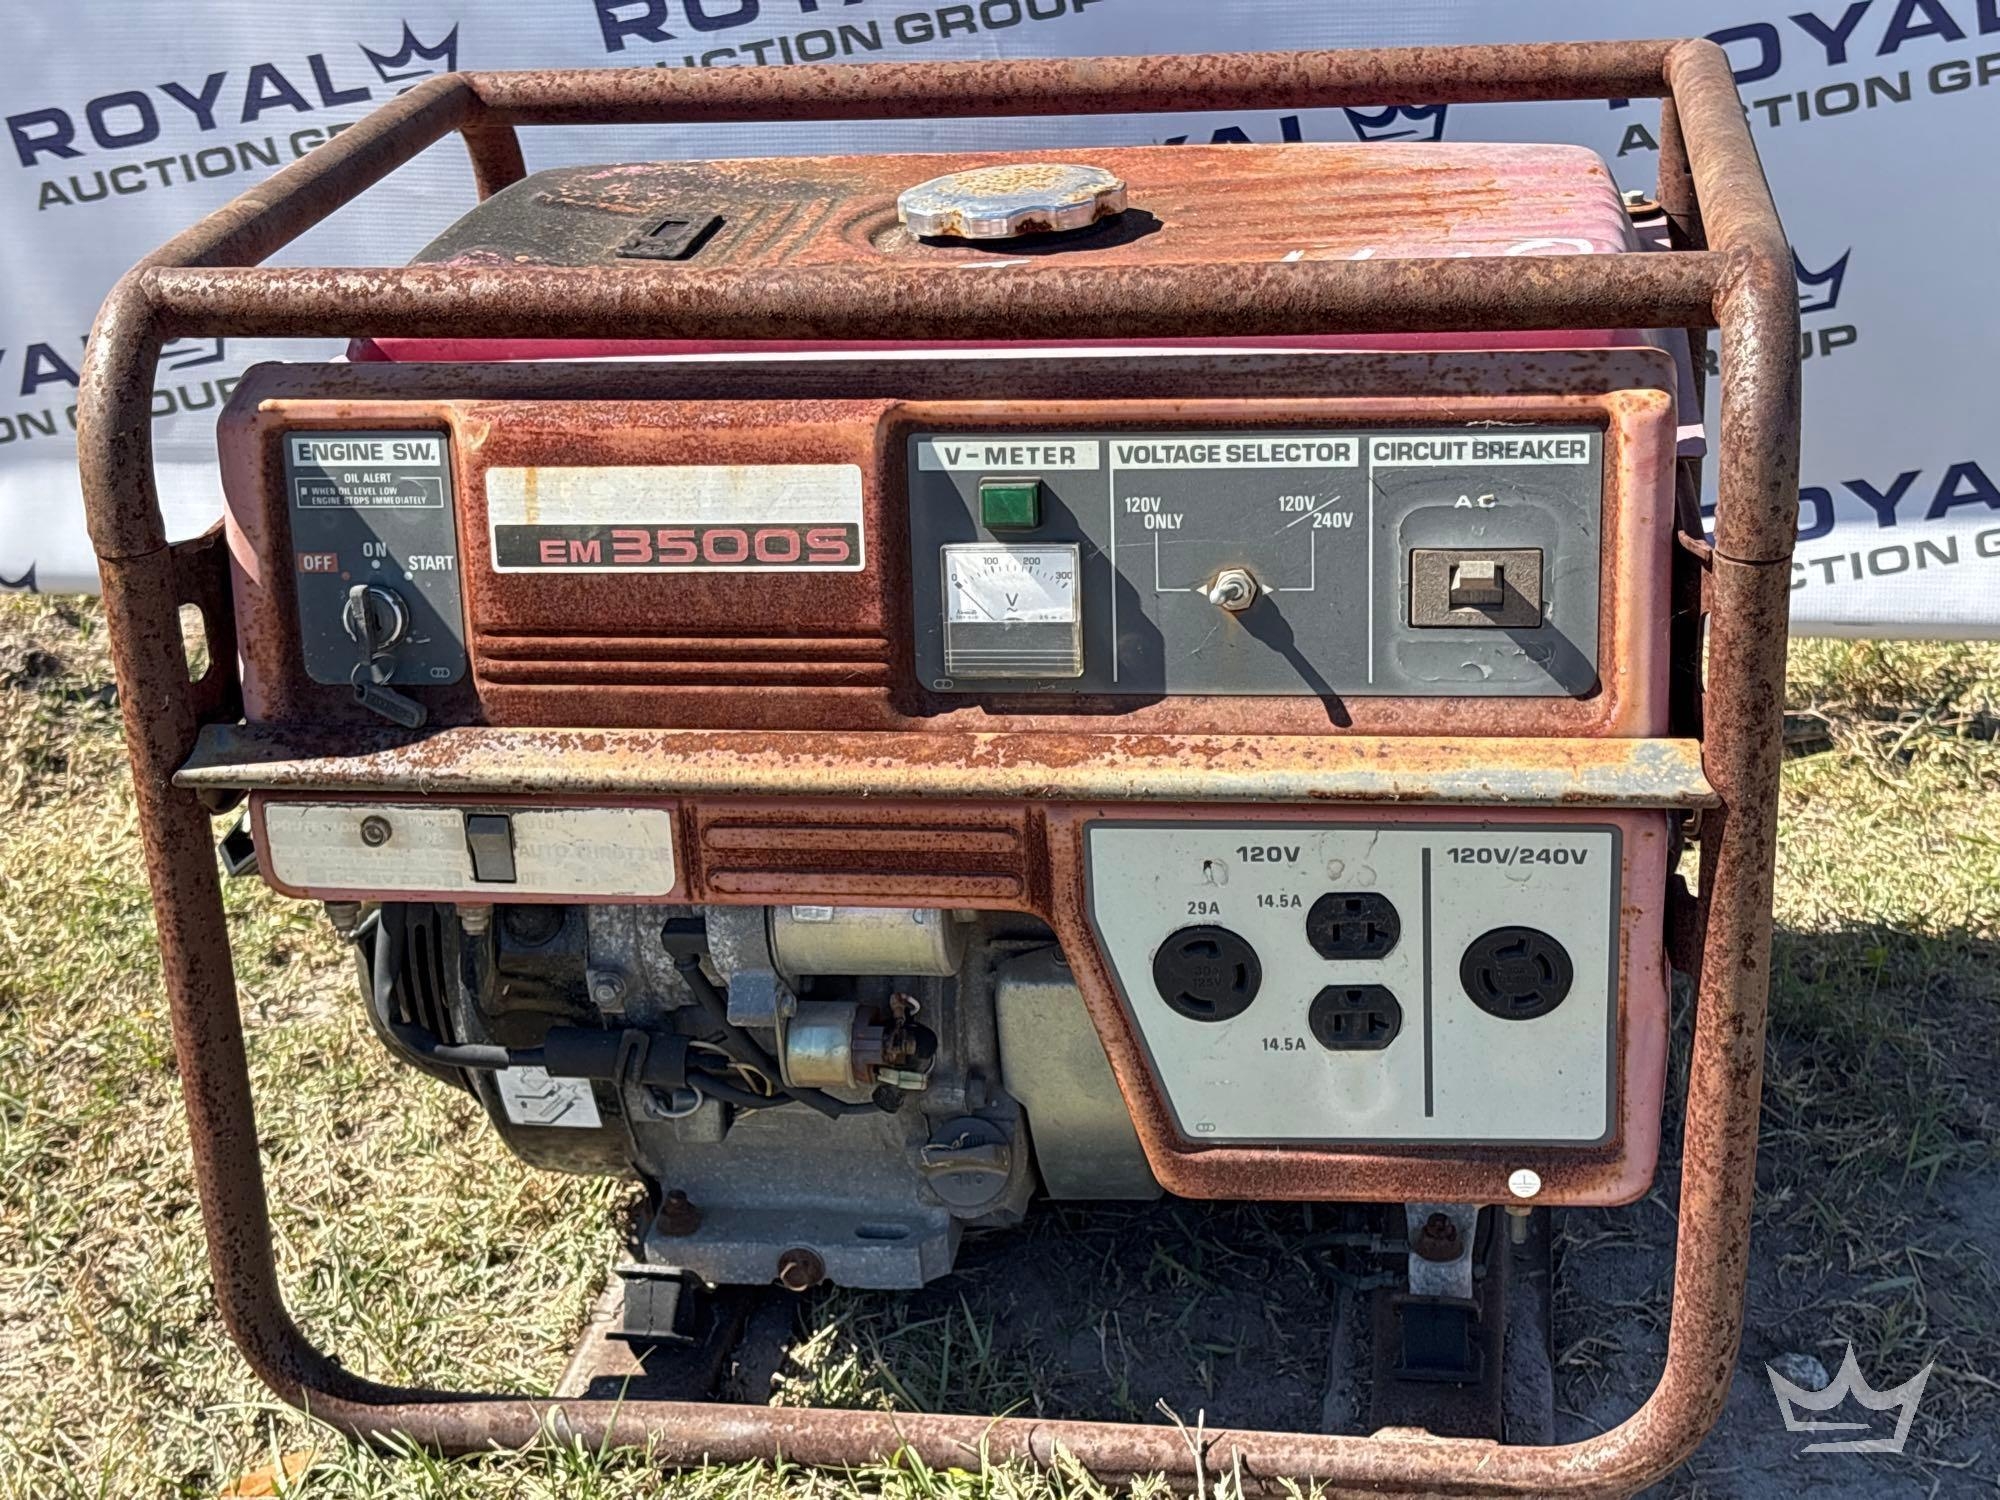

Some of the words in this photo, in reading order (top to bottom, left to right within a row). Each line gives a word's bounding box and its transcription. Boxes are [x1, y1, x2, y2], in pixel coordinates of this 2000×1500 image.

[6, 53, 373, 168] ROYAL
[38, 136, 280, 211] AUCTION
[298, 443, 384, 461] ENGINE
[392, 443, 436, 461] SW.
[1117, 444, 1221, 465] VOLTAGE
[1226, 442, 1351, 463] SELECTOR
[1373, 441, 1467, 461] CIRCUIT
[1471, 440, 1586, 460] BREAKER
[344, 473, 360, 483] OIL
[363, 472, 391, 483] ALERT
[312, 487, 336, 496] WHEN
[338, 487, 350, 496] OIL
[354, 487, 377, 495] LEVEL
[379, 487, 397, 495] LOW
[312, 496, 341, 505] ENGINE
[344, 496, 370, 505] STOPS
[373, 496, 426, 505] IMMEDIATELY
[1125, 497, 1161, 513] 120V
[1279, 496, 1316, 512] 120V
[1144, 514, 1183, 530] ONLY
[1312, 513, 1354, 529] 240V
[363, 542, 387, 557] ON
[539, 539, 601, 564] EM
[612, 527, 851, 564] 3500S
[303, 555, 332, 570] OFF
[408, 555, 454, 571] START
[983, 557, 999, 565] 100
[1023, 557, 1041, 565] 200
[951, 573, 957, 581] 0
[1055, 571, 1072, 580] 300
[1005, 593, 1019, 607] V
[1235, 845, 1301, 863] 120V
[1447, 847, 1589, 866] 120V/240V
[1187, 901, 1220, 916] 29A
[1256, 893, 1303, 909] 14.5A
[1261, 1037, 1307, 1053] 14.5A
